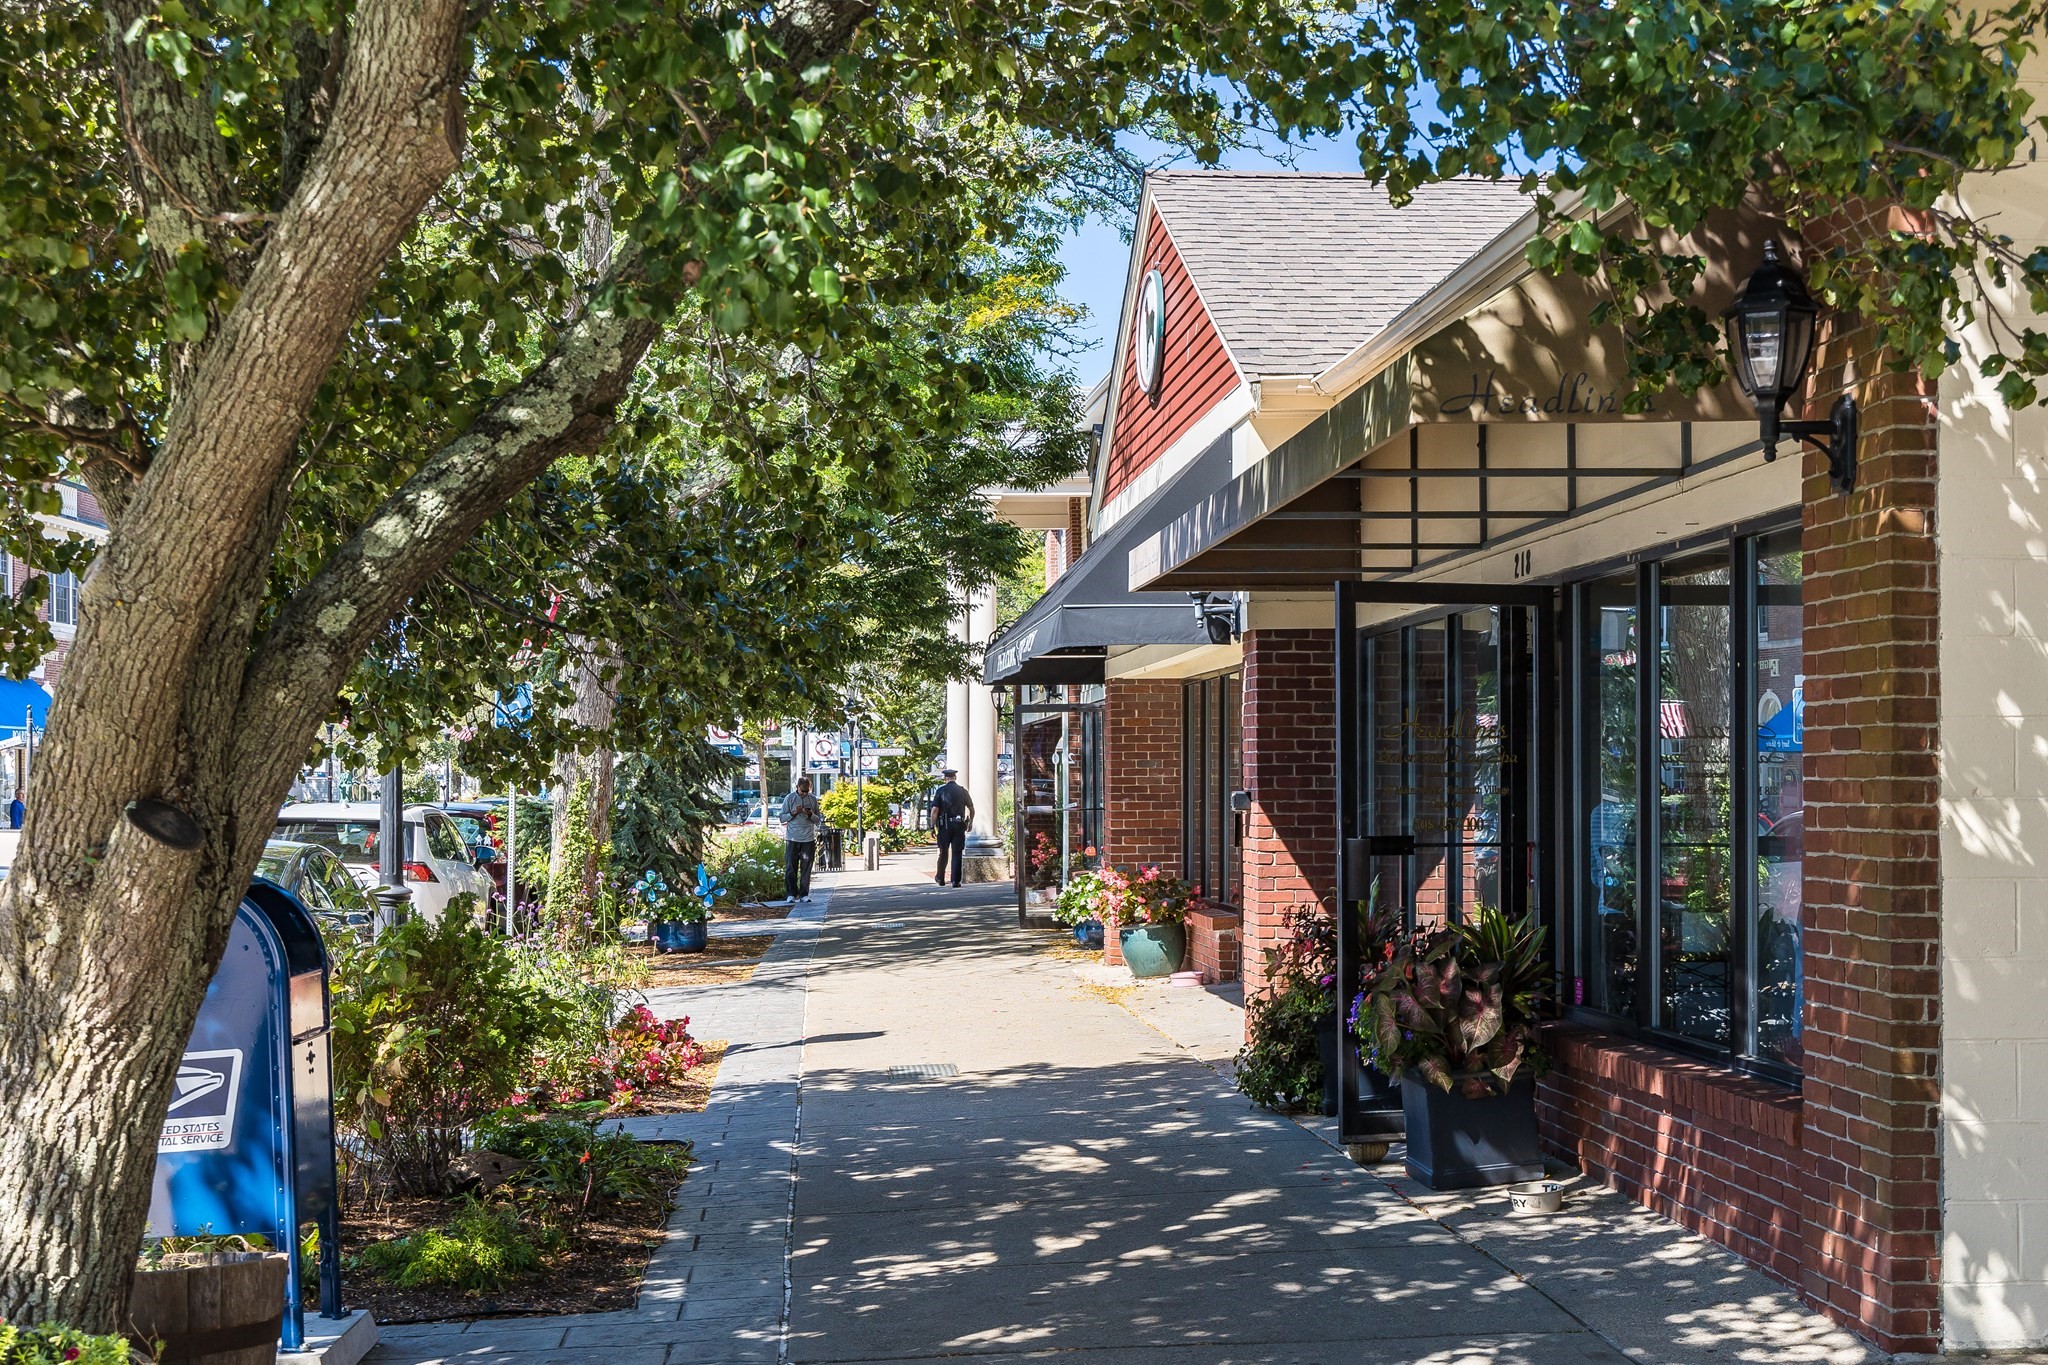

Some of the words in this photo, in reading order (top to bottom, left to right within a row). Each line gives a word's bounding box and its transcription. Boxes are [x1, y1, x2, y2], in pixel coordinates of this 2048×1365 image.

[1440, 368, 1656, 415] Headlins
[1514, 549, 1531, 579] 218
[1383, 705, 1509, 739] Headlines
[1485, 744, 1519, 768] Spa
[159, 1137, 178, 1146] TAL
[180, 1134, 224, 1145] SERVICE
[182, 1122, 220, 1133] STATES
